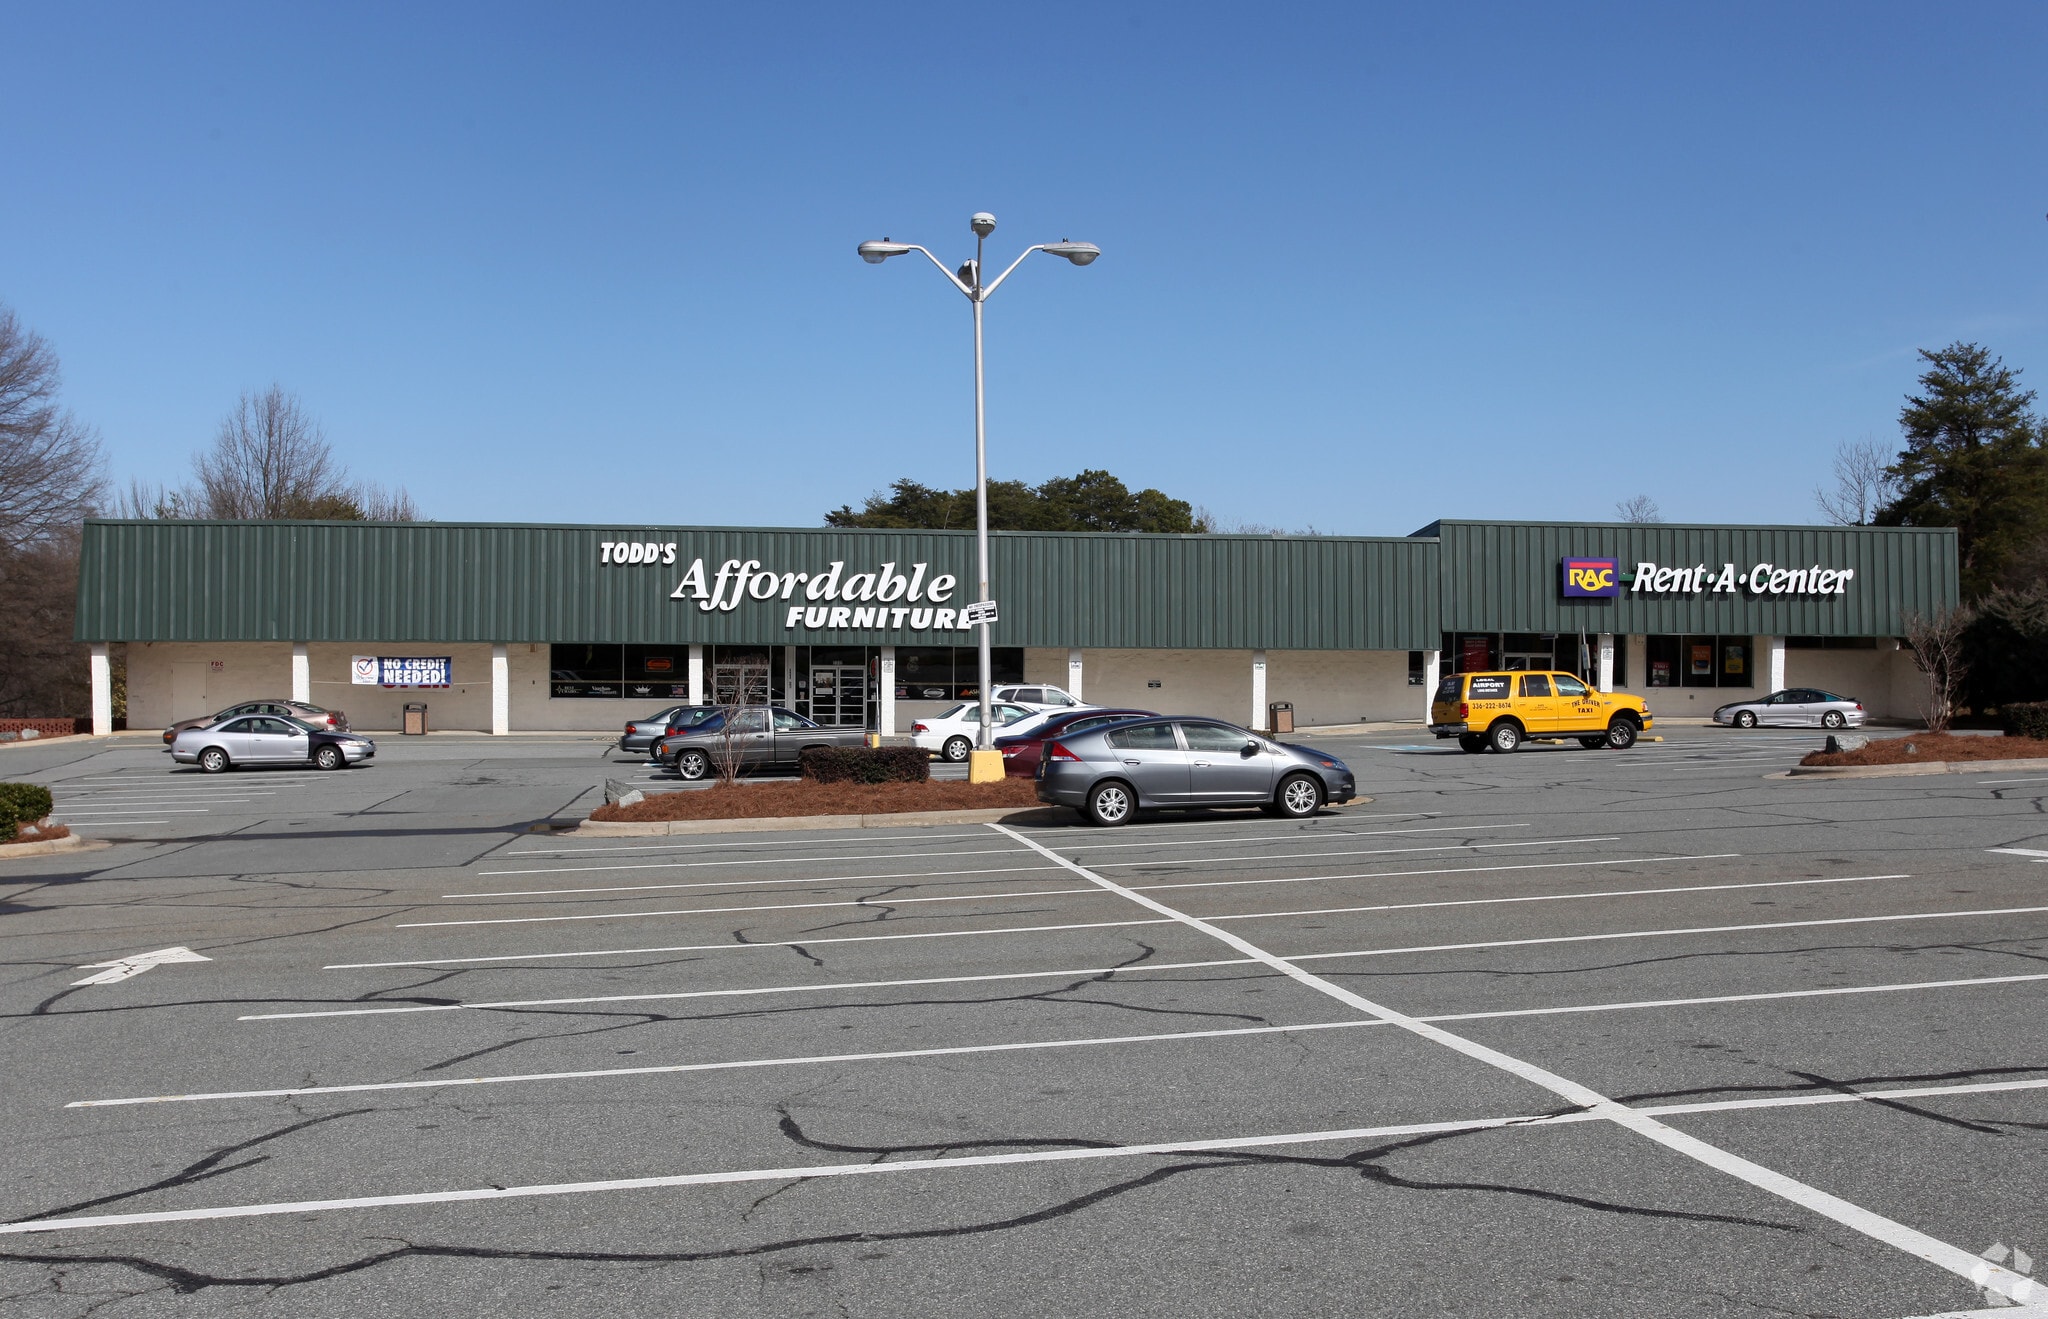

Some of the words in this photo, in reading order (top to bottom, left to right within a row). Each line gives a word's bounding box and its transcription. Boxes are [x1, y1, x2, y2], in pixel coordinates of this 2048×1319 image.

[601, 542, 677, 564] TODD'S
[670, 558, 956, 611] Affordable
[1569, 569, 1613, 591] RAC
[384, 658, 401, 669] NO
[405, 659, 447, 670] CREDIT
[384, 669, 446, 683] NEEDED!
[1571, 699, 1581, 708] THE
[1582, 698, 1601, 708] DRIVER
